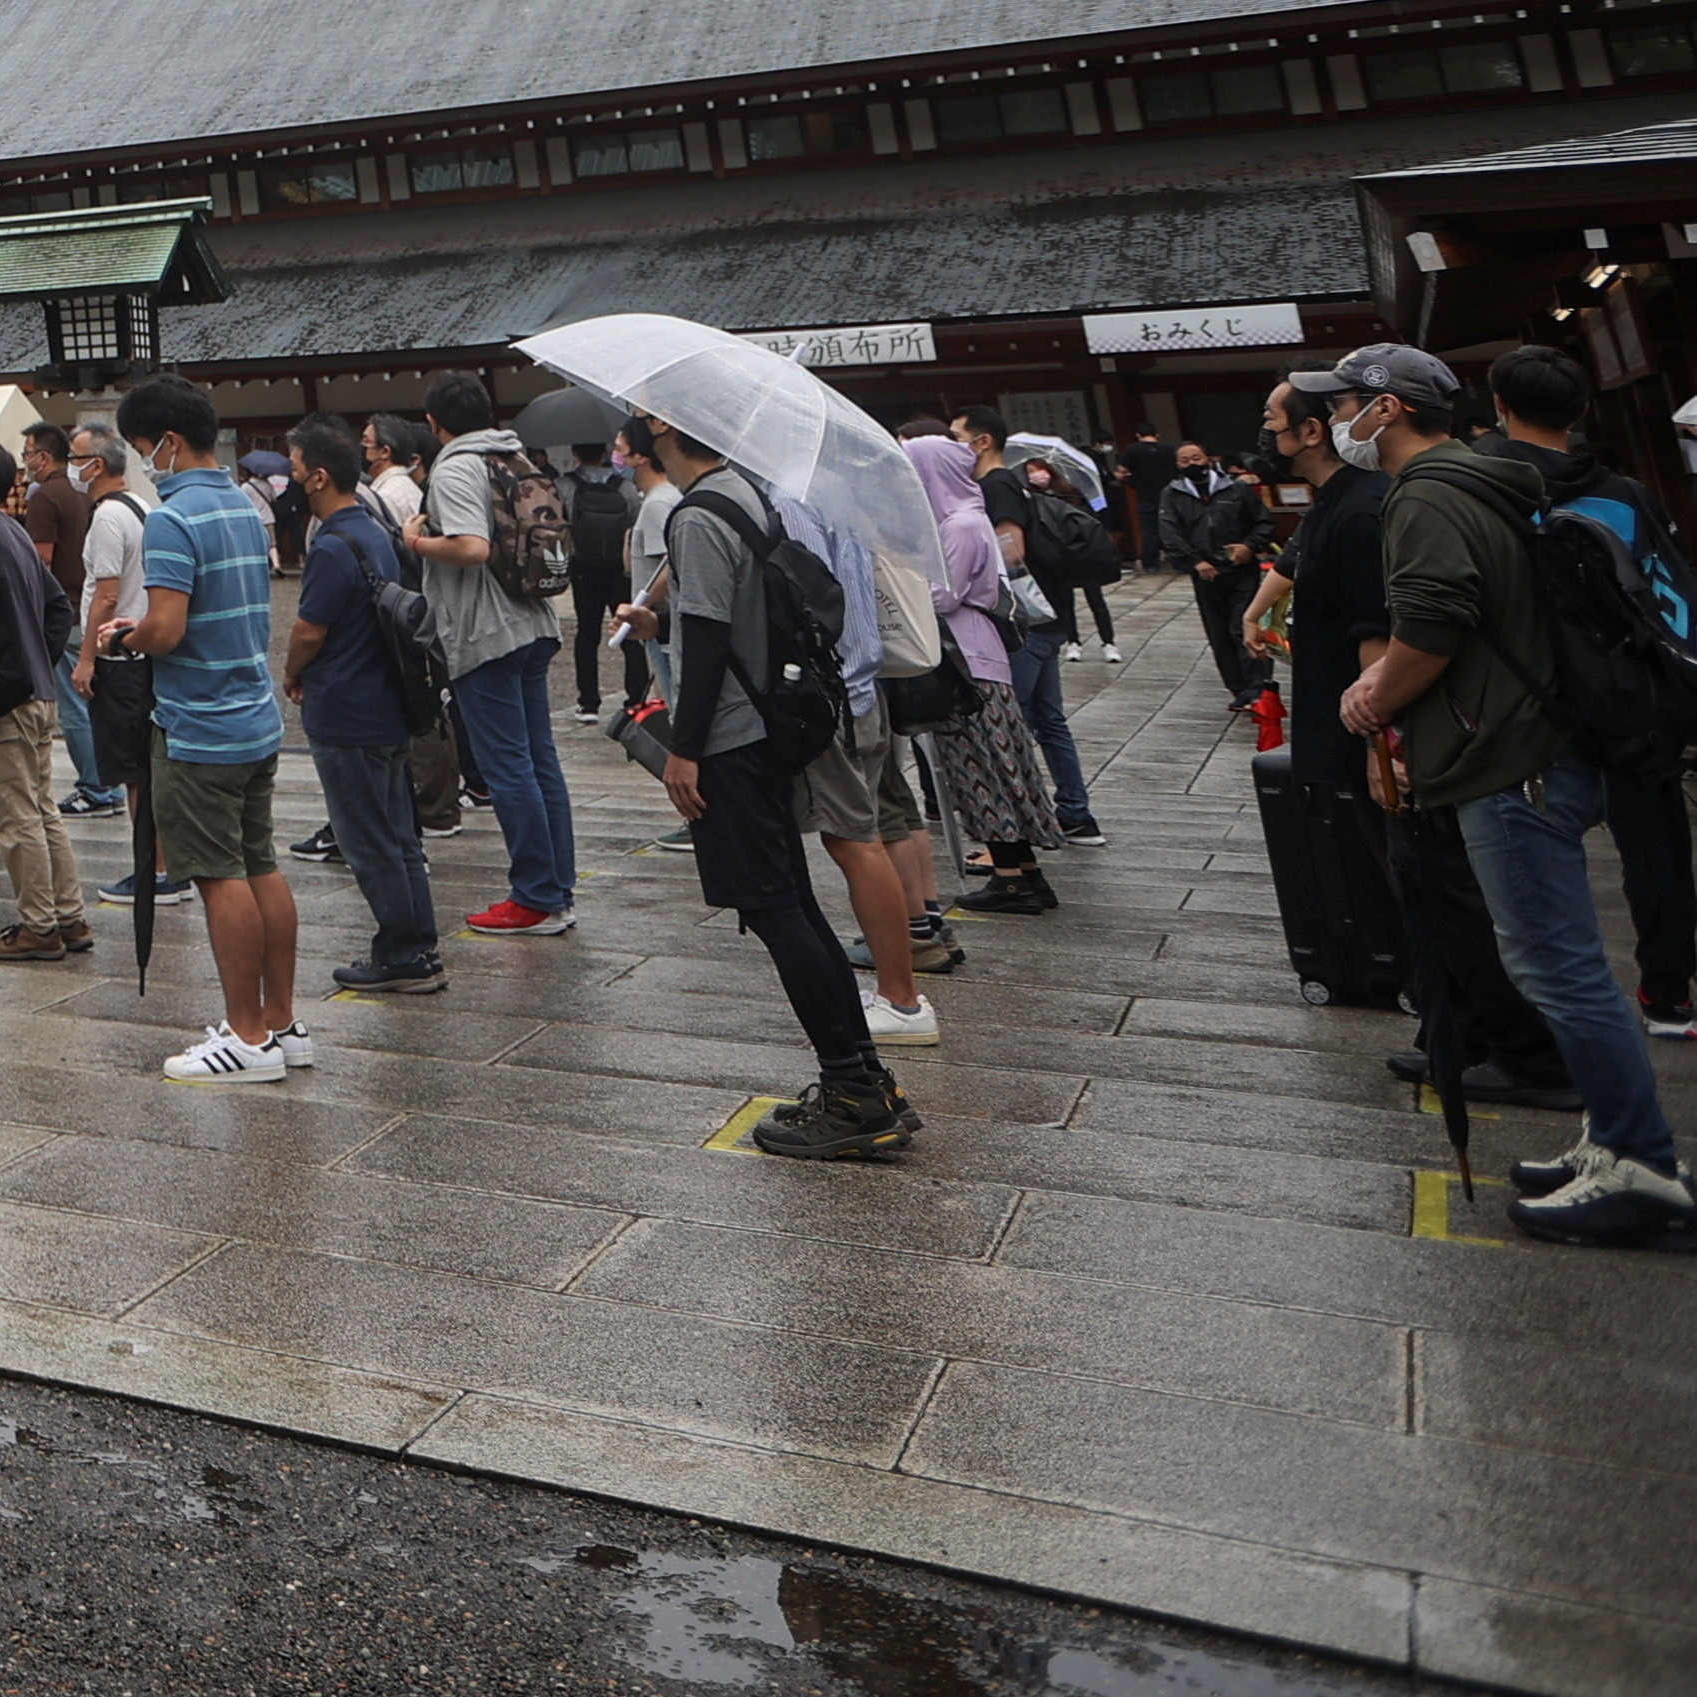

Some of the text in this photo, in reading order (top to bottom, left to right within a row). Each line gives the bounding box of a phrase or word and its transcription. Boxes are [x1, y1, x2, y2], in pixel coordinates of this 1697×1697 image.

[1140, 318, 1244, 342] おみくじ
[754, 327, 926, 366] 時頒布所
[874, 588, 898, 618] OTEL
[878, 622, 904, 633] ouse
